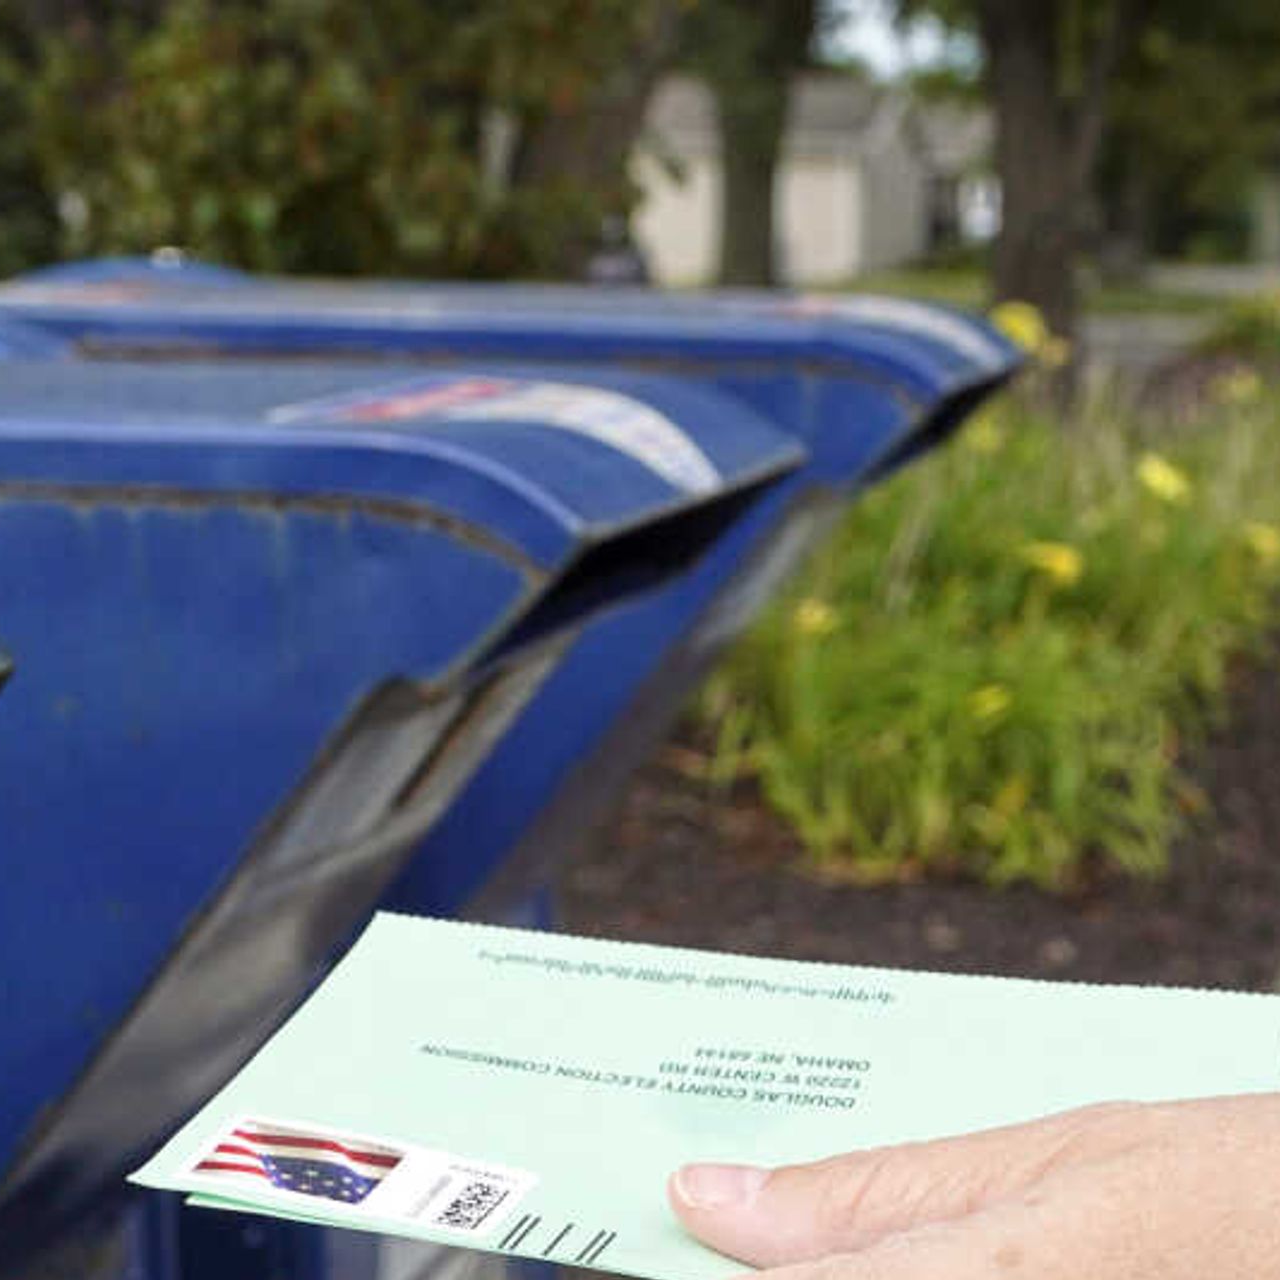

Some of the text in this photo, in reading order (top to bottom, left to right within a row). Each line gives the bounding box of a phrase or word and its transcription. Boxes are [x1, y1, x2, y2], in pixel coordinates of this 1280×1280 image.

[757, 1053, 785, 1064] NE
[658, 1062, 689, 1073] RD
[693, 1066, 776, 1083] CENTER
[554, 1066, 657, 1088] ELECTION
[780, 1074, 800, 1084] W
[660, 1082, 747, 1099] COUNTY
[754, 1091, 855, 1109] DOUGLAS
